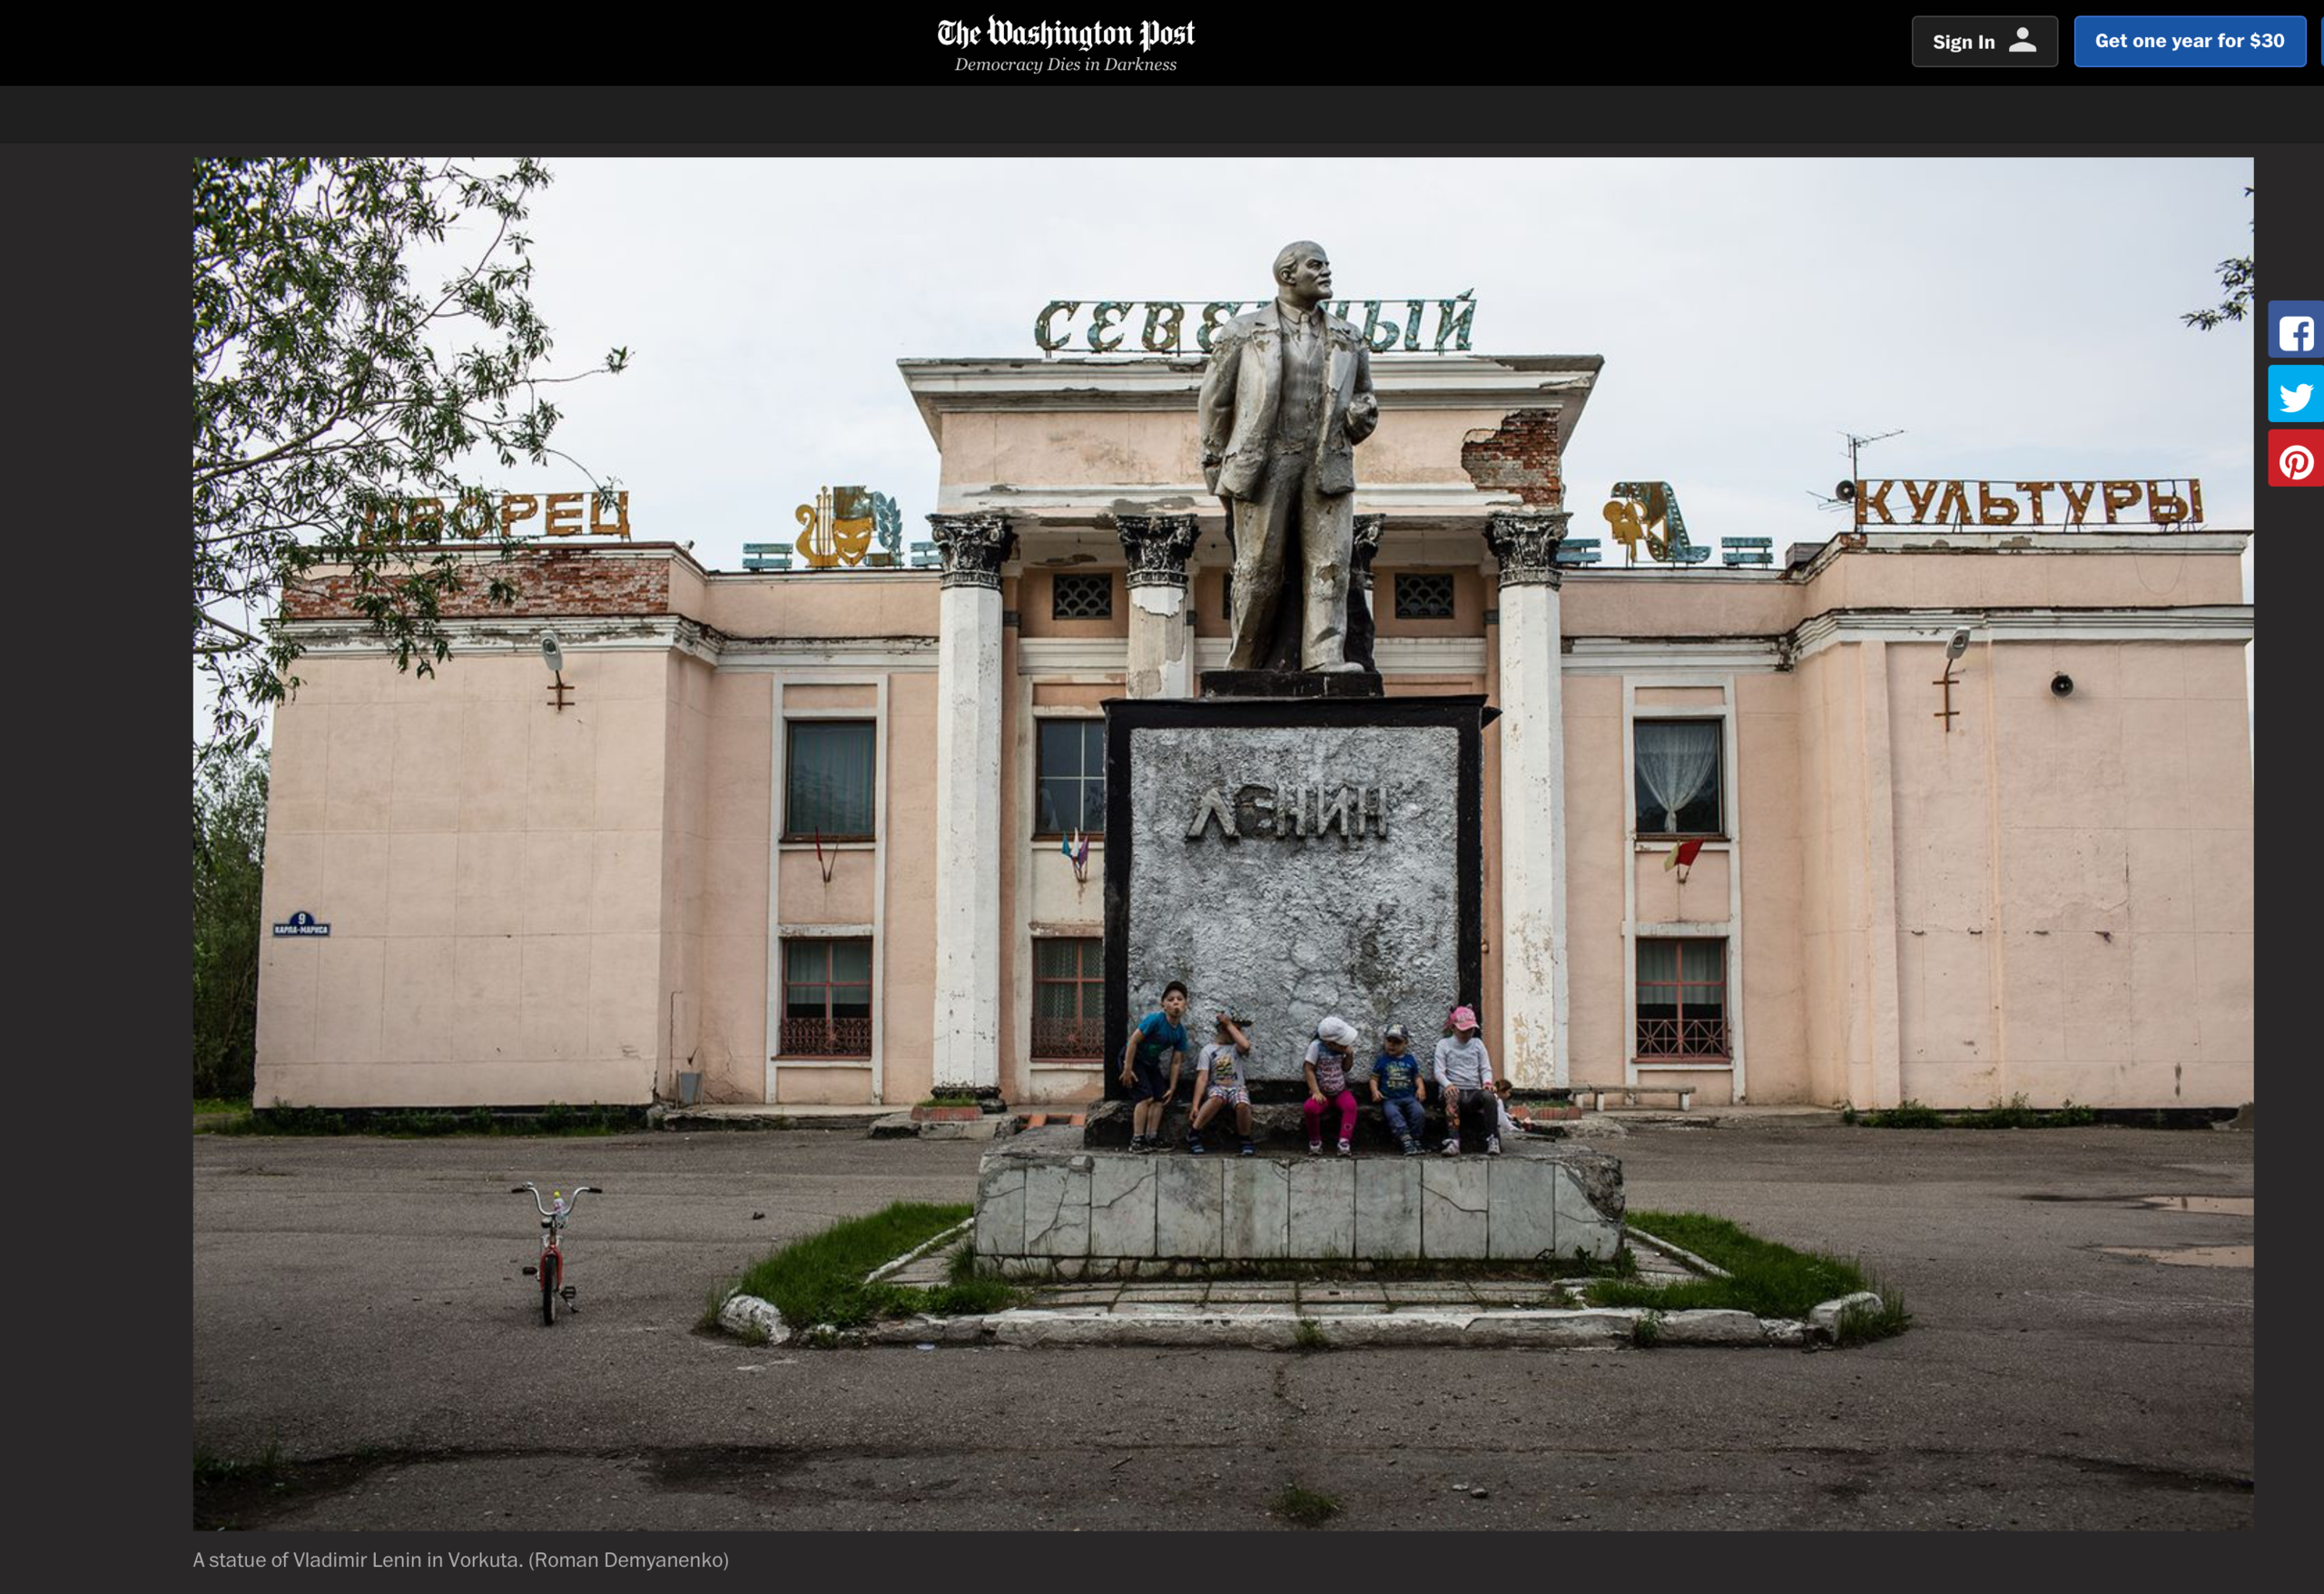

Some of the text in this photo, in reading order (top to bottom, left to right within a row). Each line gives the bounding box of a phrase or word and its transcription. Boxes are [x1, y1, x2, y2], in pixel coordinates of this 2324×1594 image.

[1034, 288, 1478, 352] СЕВЕЫЙ
[1856, 478, 2204, 526] КУЛЬТУРЫ
[1184, 783, 1389, 840] ЛЕНИН
[298, 913, 306, 925] 9
